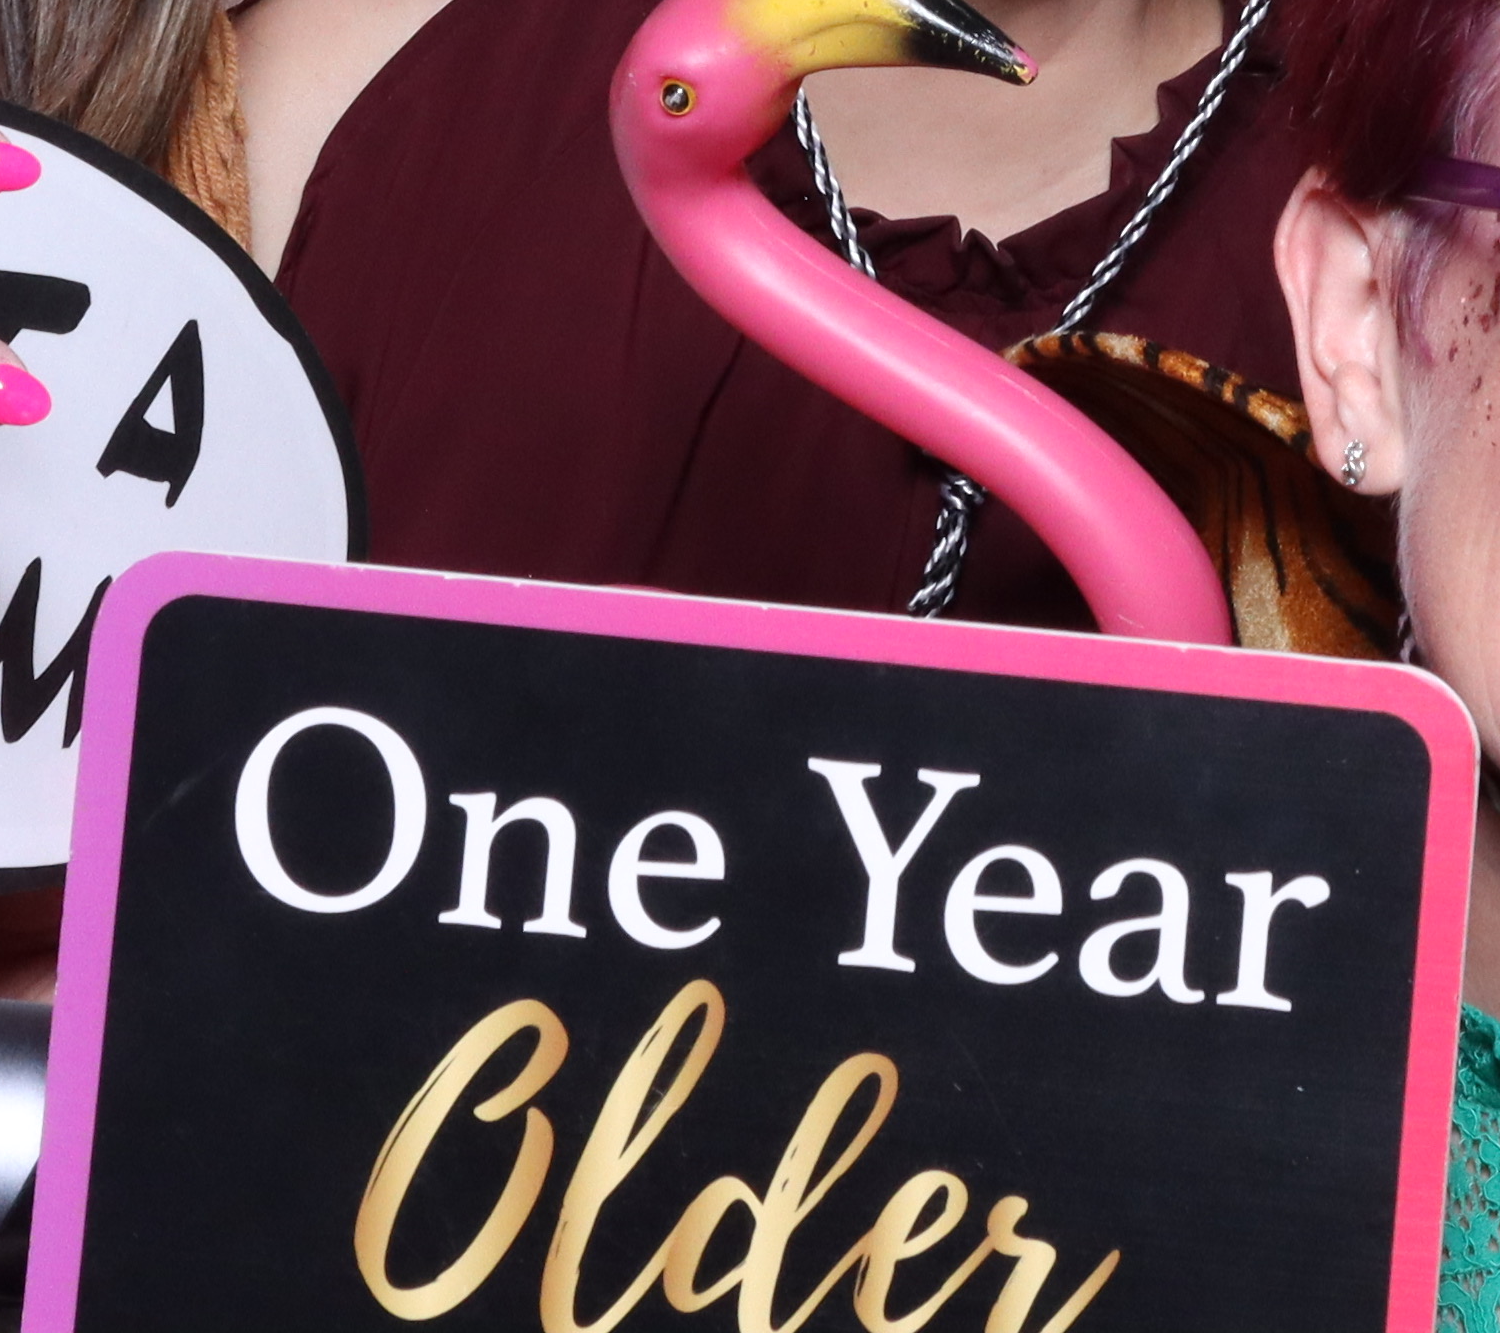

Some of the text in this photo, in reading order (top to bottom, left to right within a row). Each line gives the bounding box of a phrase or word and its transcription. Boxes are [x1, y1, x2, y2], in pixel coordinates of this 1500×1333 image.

[95, 318, 205, 510] A
[233, 705, 1332, 1014] One Year
[352, 977, 1122, 1333] Older
